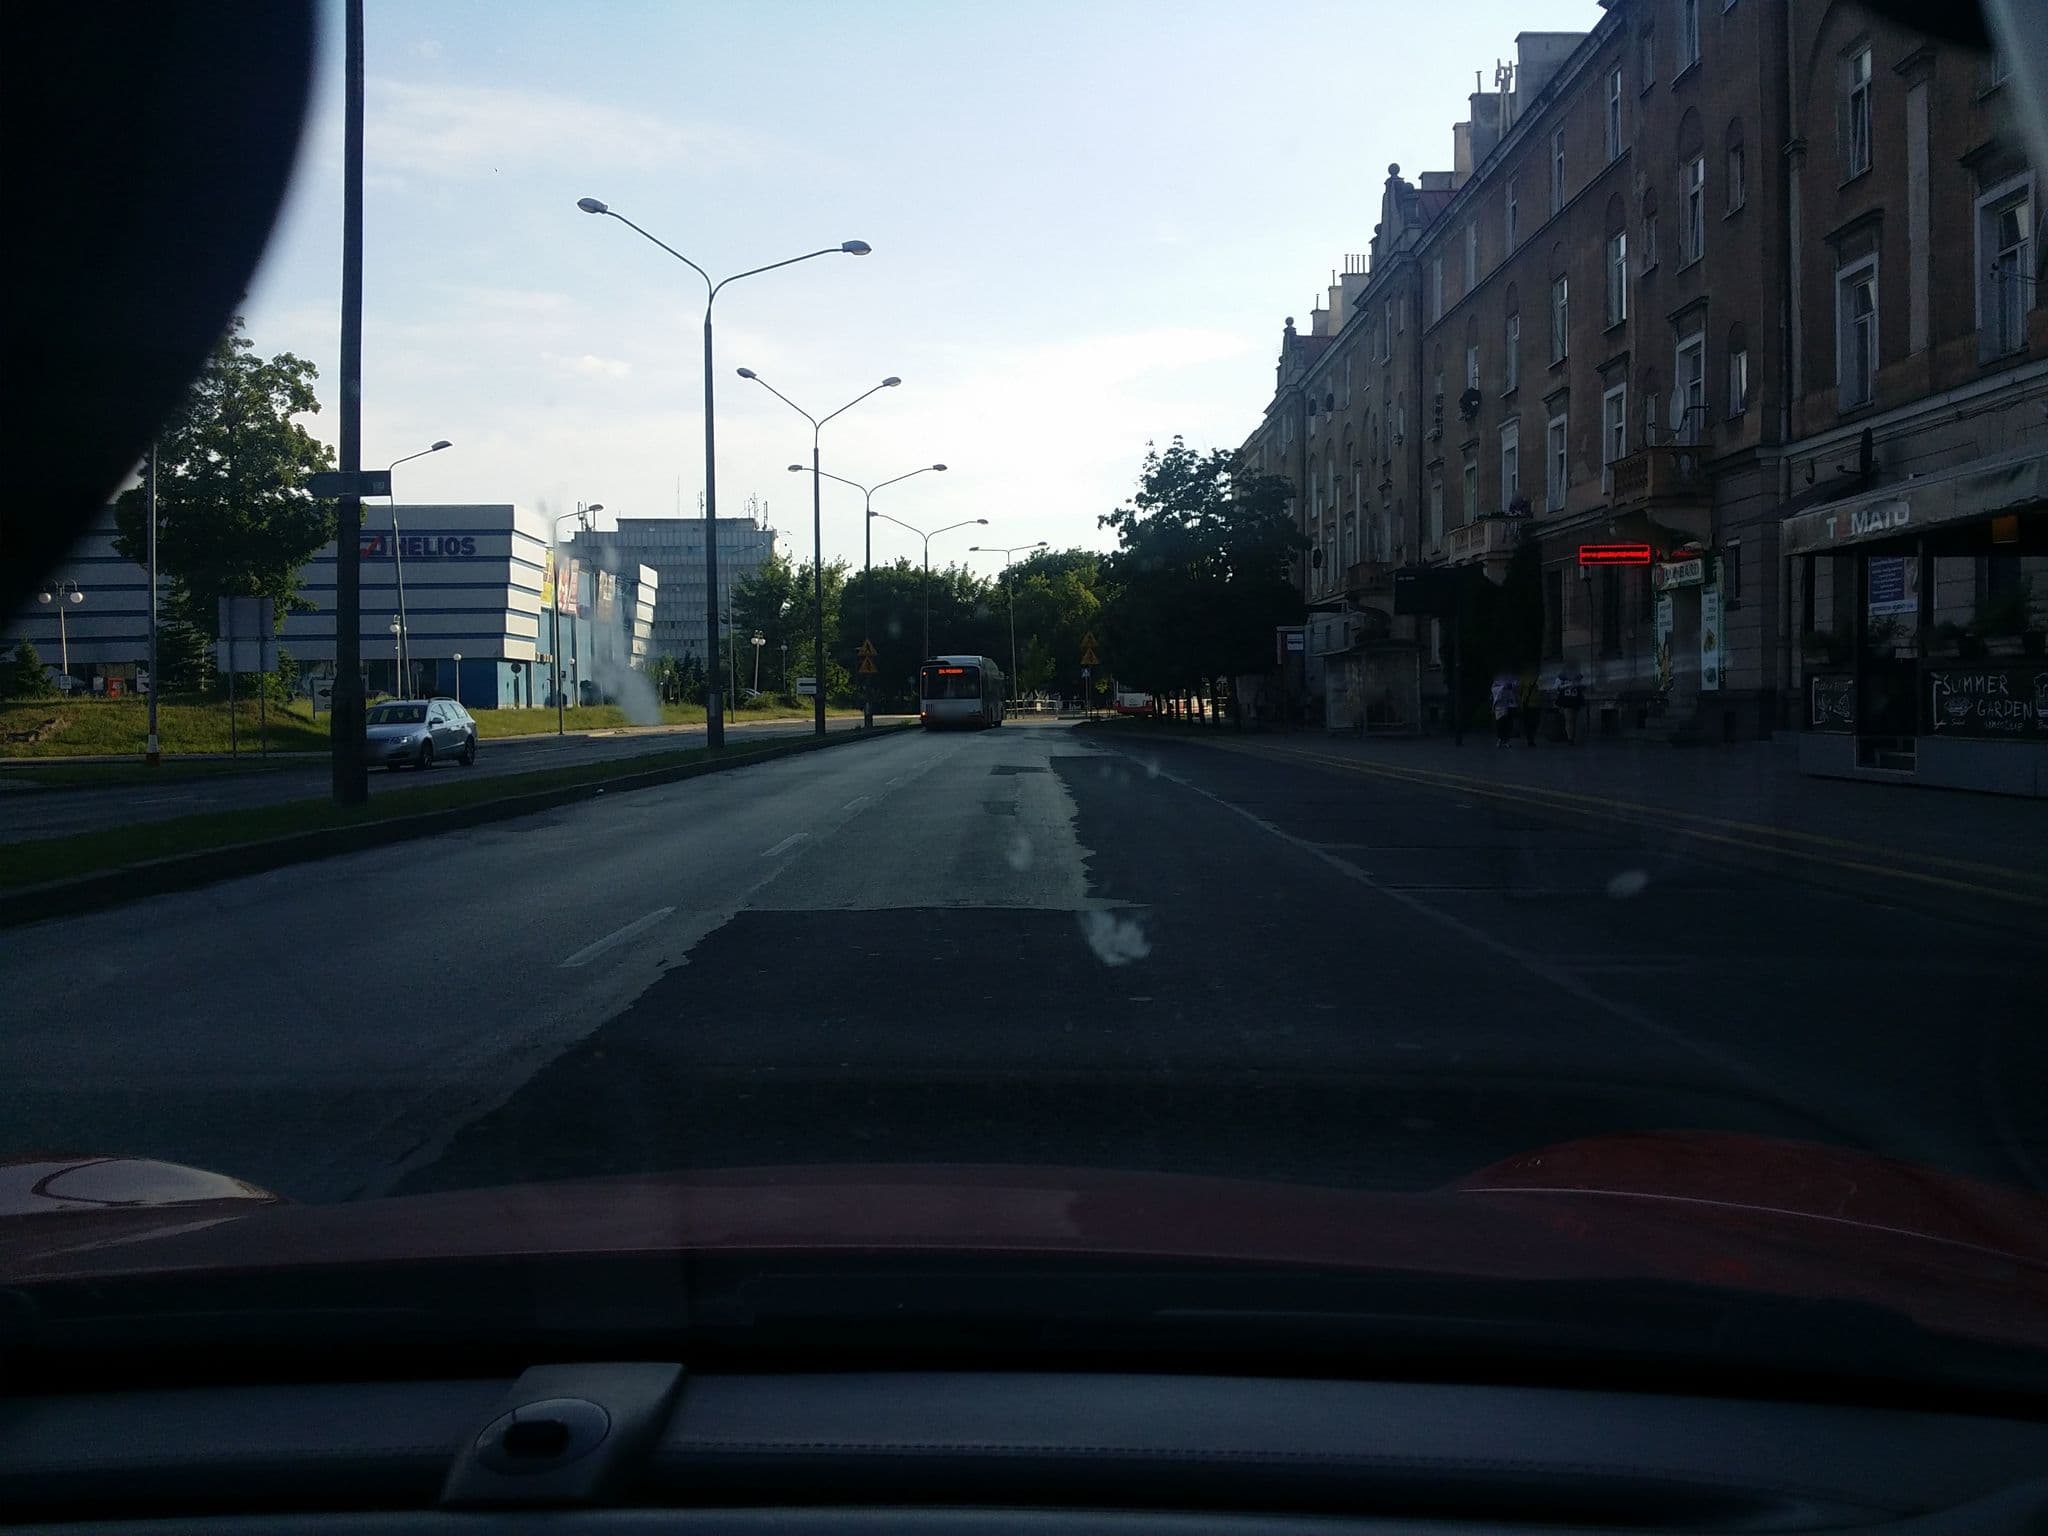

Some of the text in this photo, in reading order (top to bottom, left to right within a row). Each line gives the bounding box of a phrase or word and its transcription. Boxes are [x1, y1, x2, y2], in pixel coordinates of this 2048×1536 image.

[391, 536, 477, 556] HELIOS
[1942, 674, 2009, 696] SUMMER
[1976, 699, 2033, 721] GARDEN
